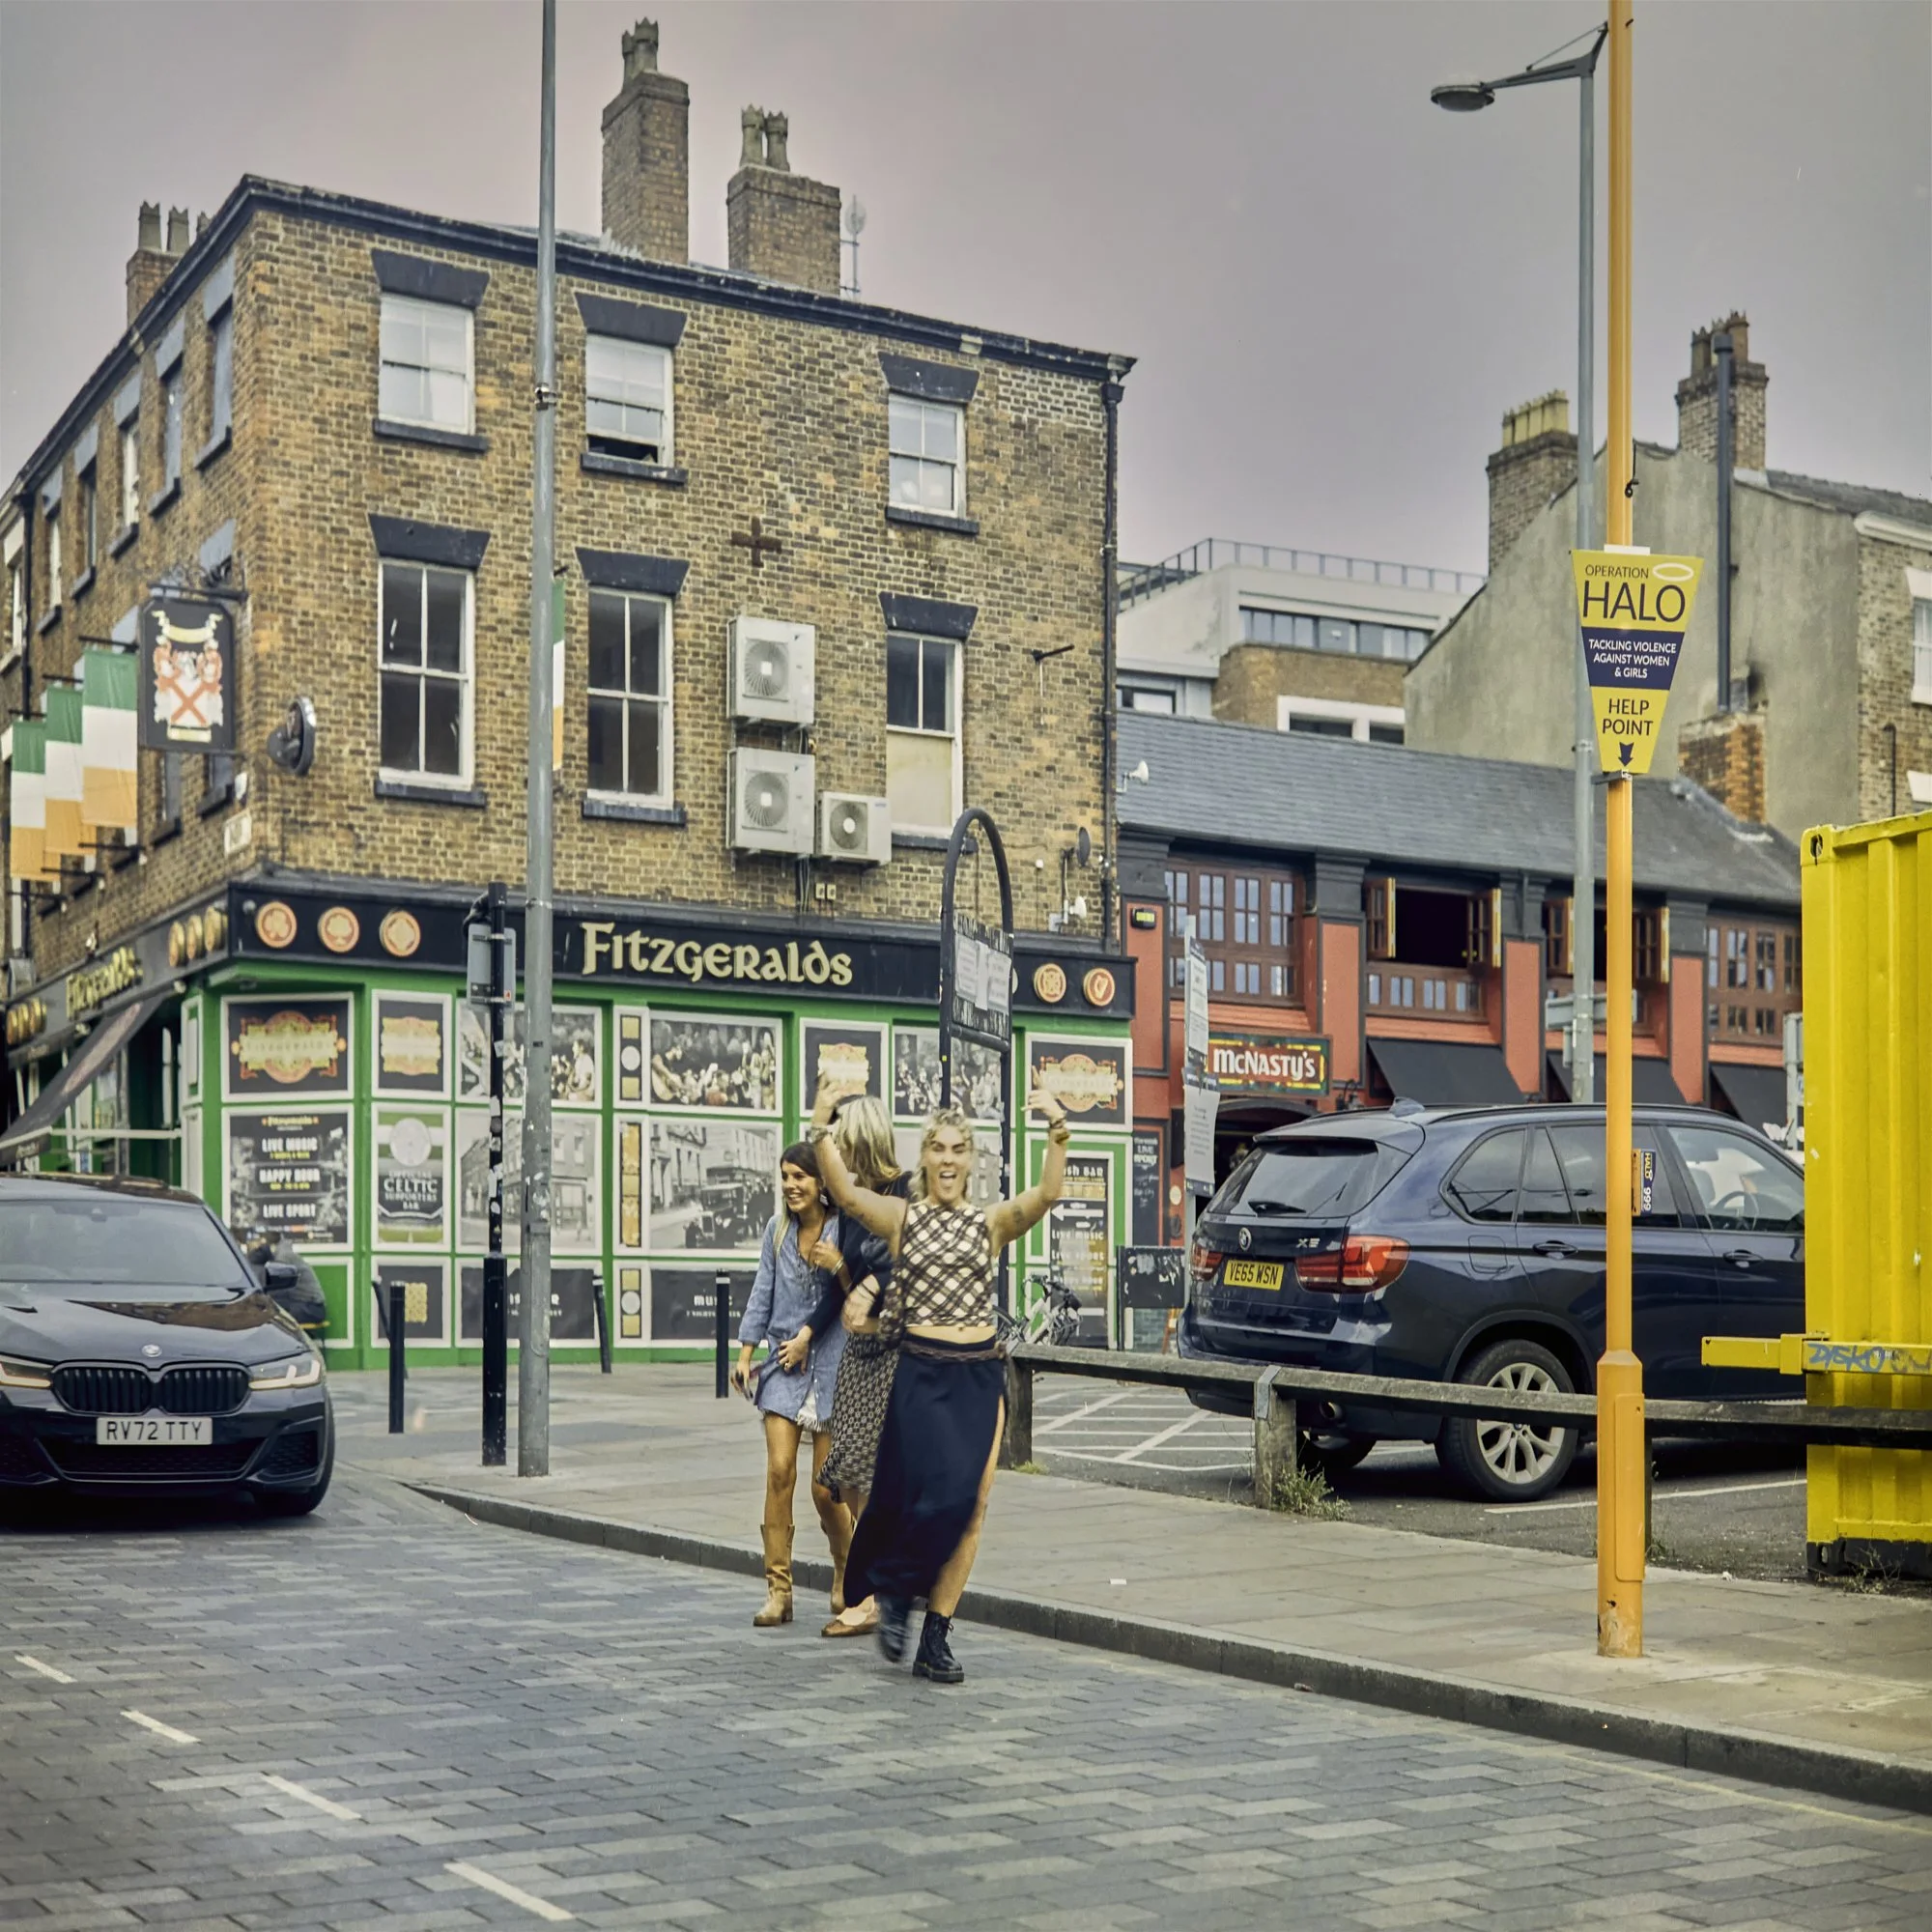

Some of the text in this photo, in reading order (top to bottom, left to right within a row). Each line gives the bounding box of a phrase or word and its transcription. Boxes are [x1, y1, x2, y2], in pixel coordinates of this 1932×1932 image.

[1584, 564, 1649, 579] OPERATION
[1582, 581, 1686, 623] HALO
[1588, 639, 1677, 654] TACKLING VIOLENCE
[1593, 652, 1670, 667] AGAINST WOMEN
[1614, 667, 1648, 679] & GIRLS
[1608, 697, 1650, 716] HELP
[1602, 718, 1654, 736] POINT
[581, 922, 854, 986] Fitzgeralds
[1083, 1166, 1104, 1177] BAR
[384, 1178, 439, 1193] CELTIC
[1229, 1263, 1280, 1286] VE65 WSN
[106, 1420, 203, 1441] RV72 TTY
